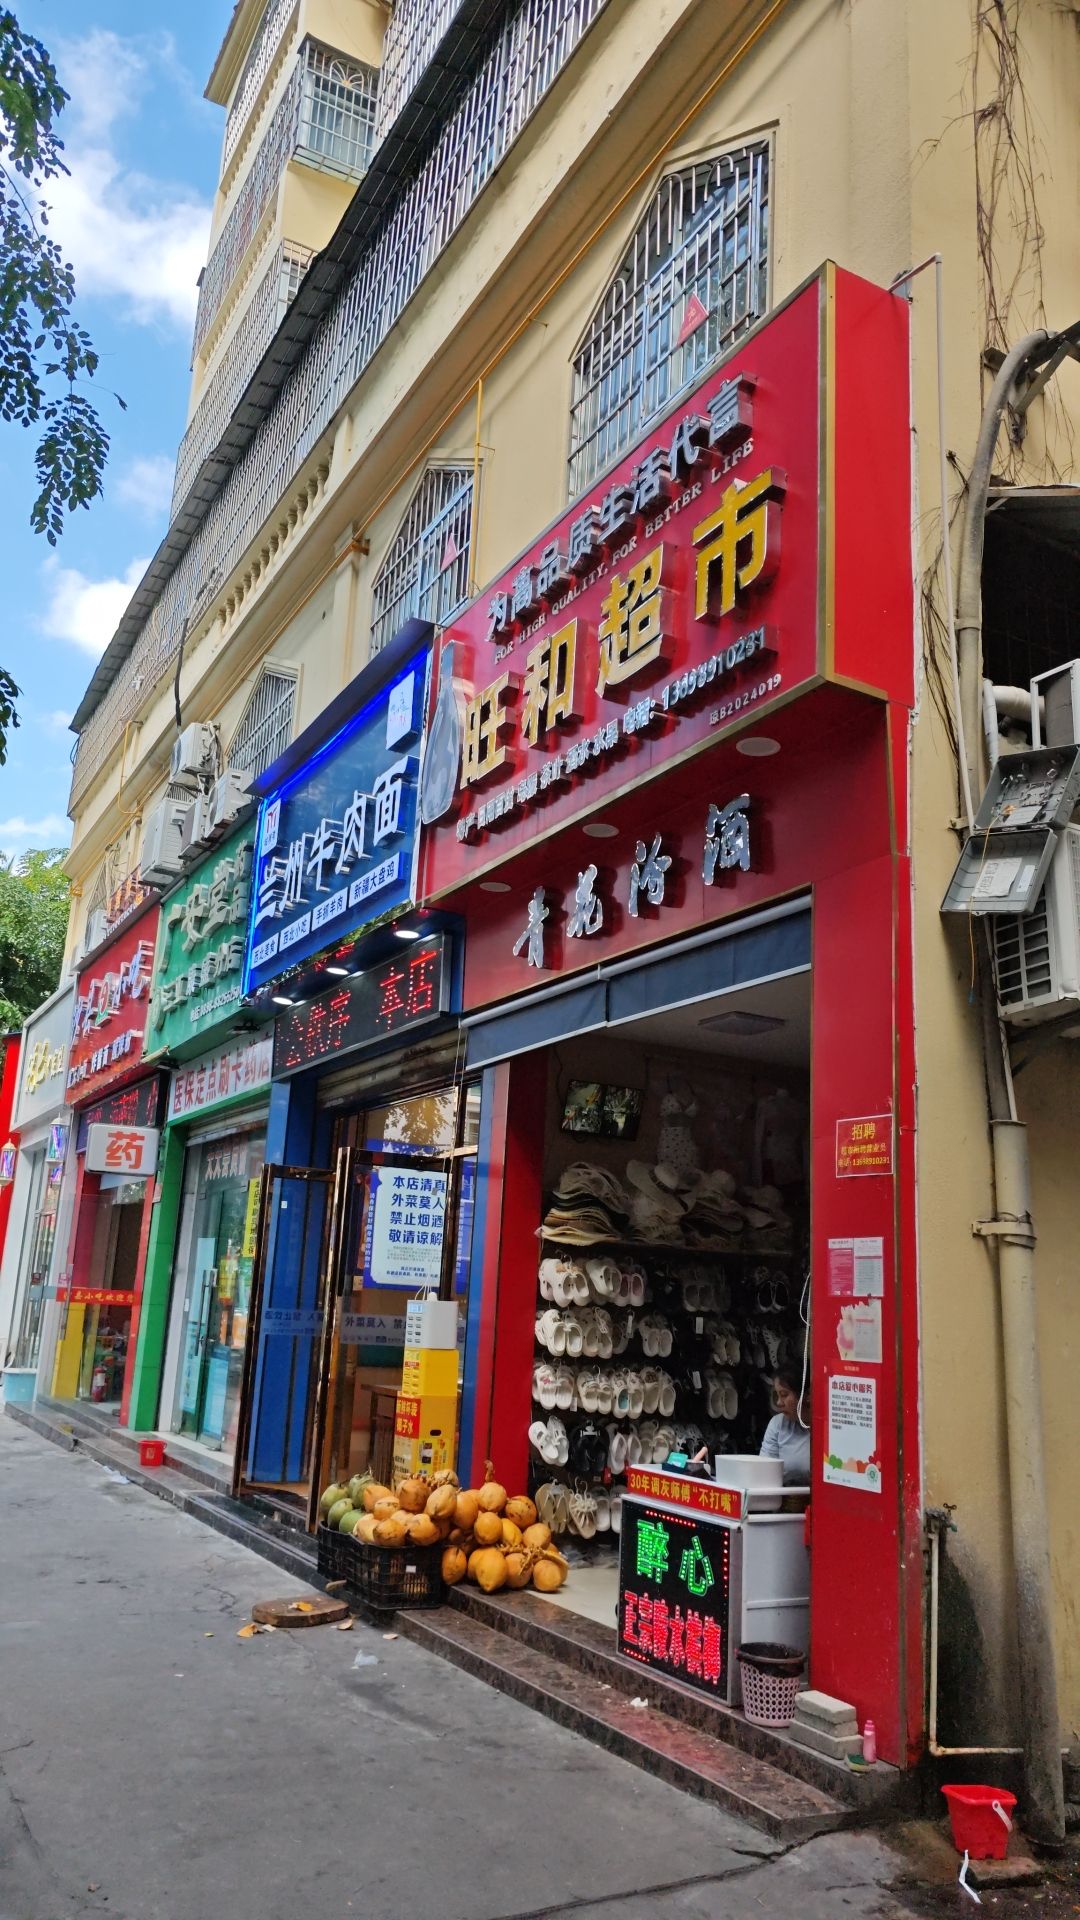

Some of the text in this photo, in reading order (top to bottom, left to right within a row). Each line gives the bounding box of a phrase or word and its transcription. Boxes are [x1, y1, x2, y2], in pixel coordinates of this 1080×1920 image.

[486, 373, 744, 642] 为高品质生活代言
[494, 644, 514, 665] FOR
[518, 612, 547, 642] HIGH
[611, 536, 638, 569] FOR
[644, 484, 703, 539] BETTER
[710, 438, 755, 483] LIFE
[460, 467, 774, 790] 旺和超市
[254, 755, 408, 928] 兰州牛肉面
[354, 861, 395, 899] 新疆大盘鸡
[173, 1032, 272, 1115] 医保定点刷卡药店
[105, 1131, 145, 1169] 药
[851, 1121, 876, 1140] 招聘
[393, 1175, 447, 1193] 本店清真
[388, 1229, 443, 1246] 敬请谅解
[390, 1211, 443, 1228] 禁止烟酒
[636, 1519, 715, 1596] 醉心
